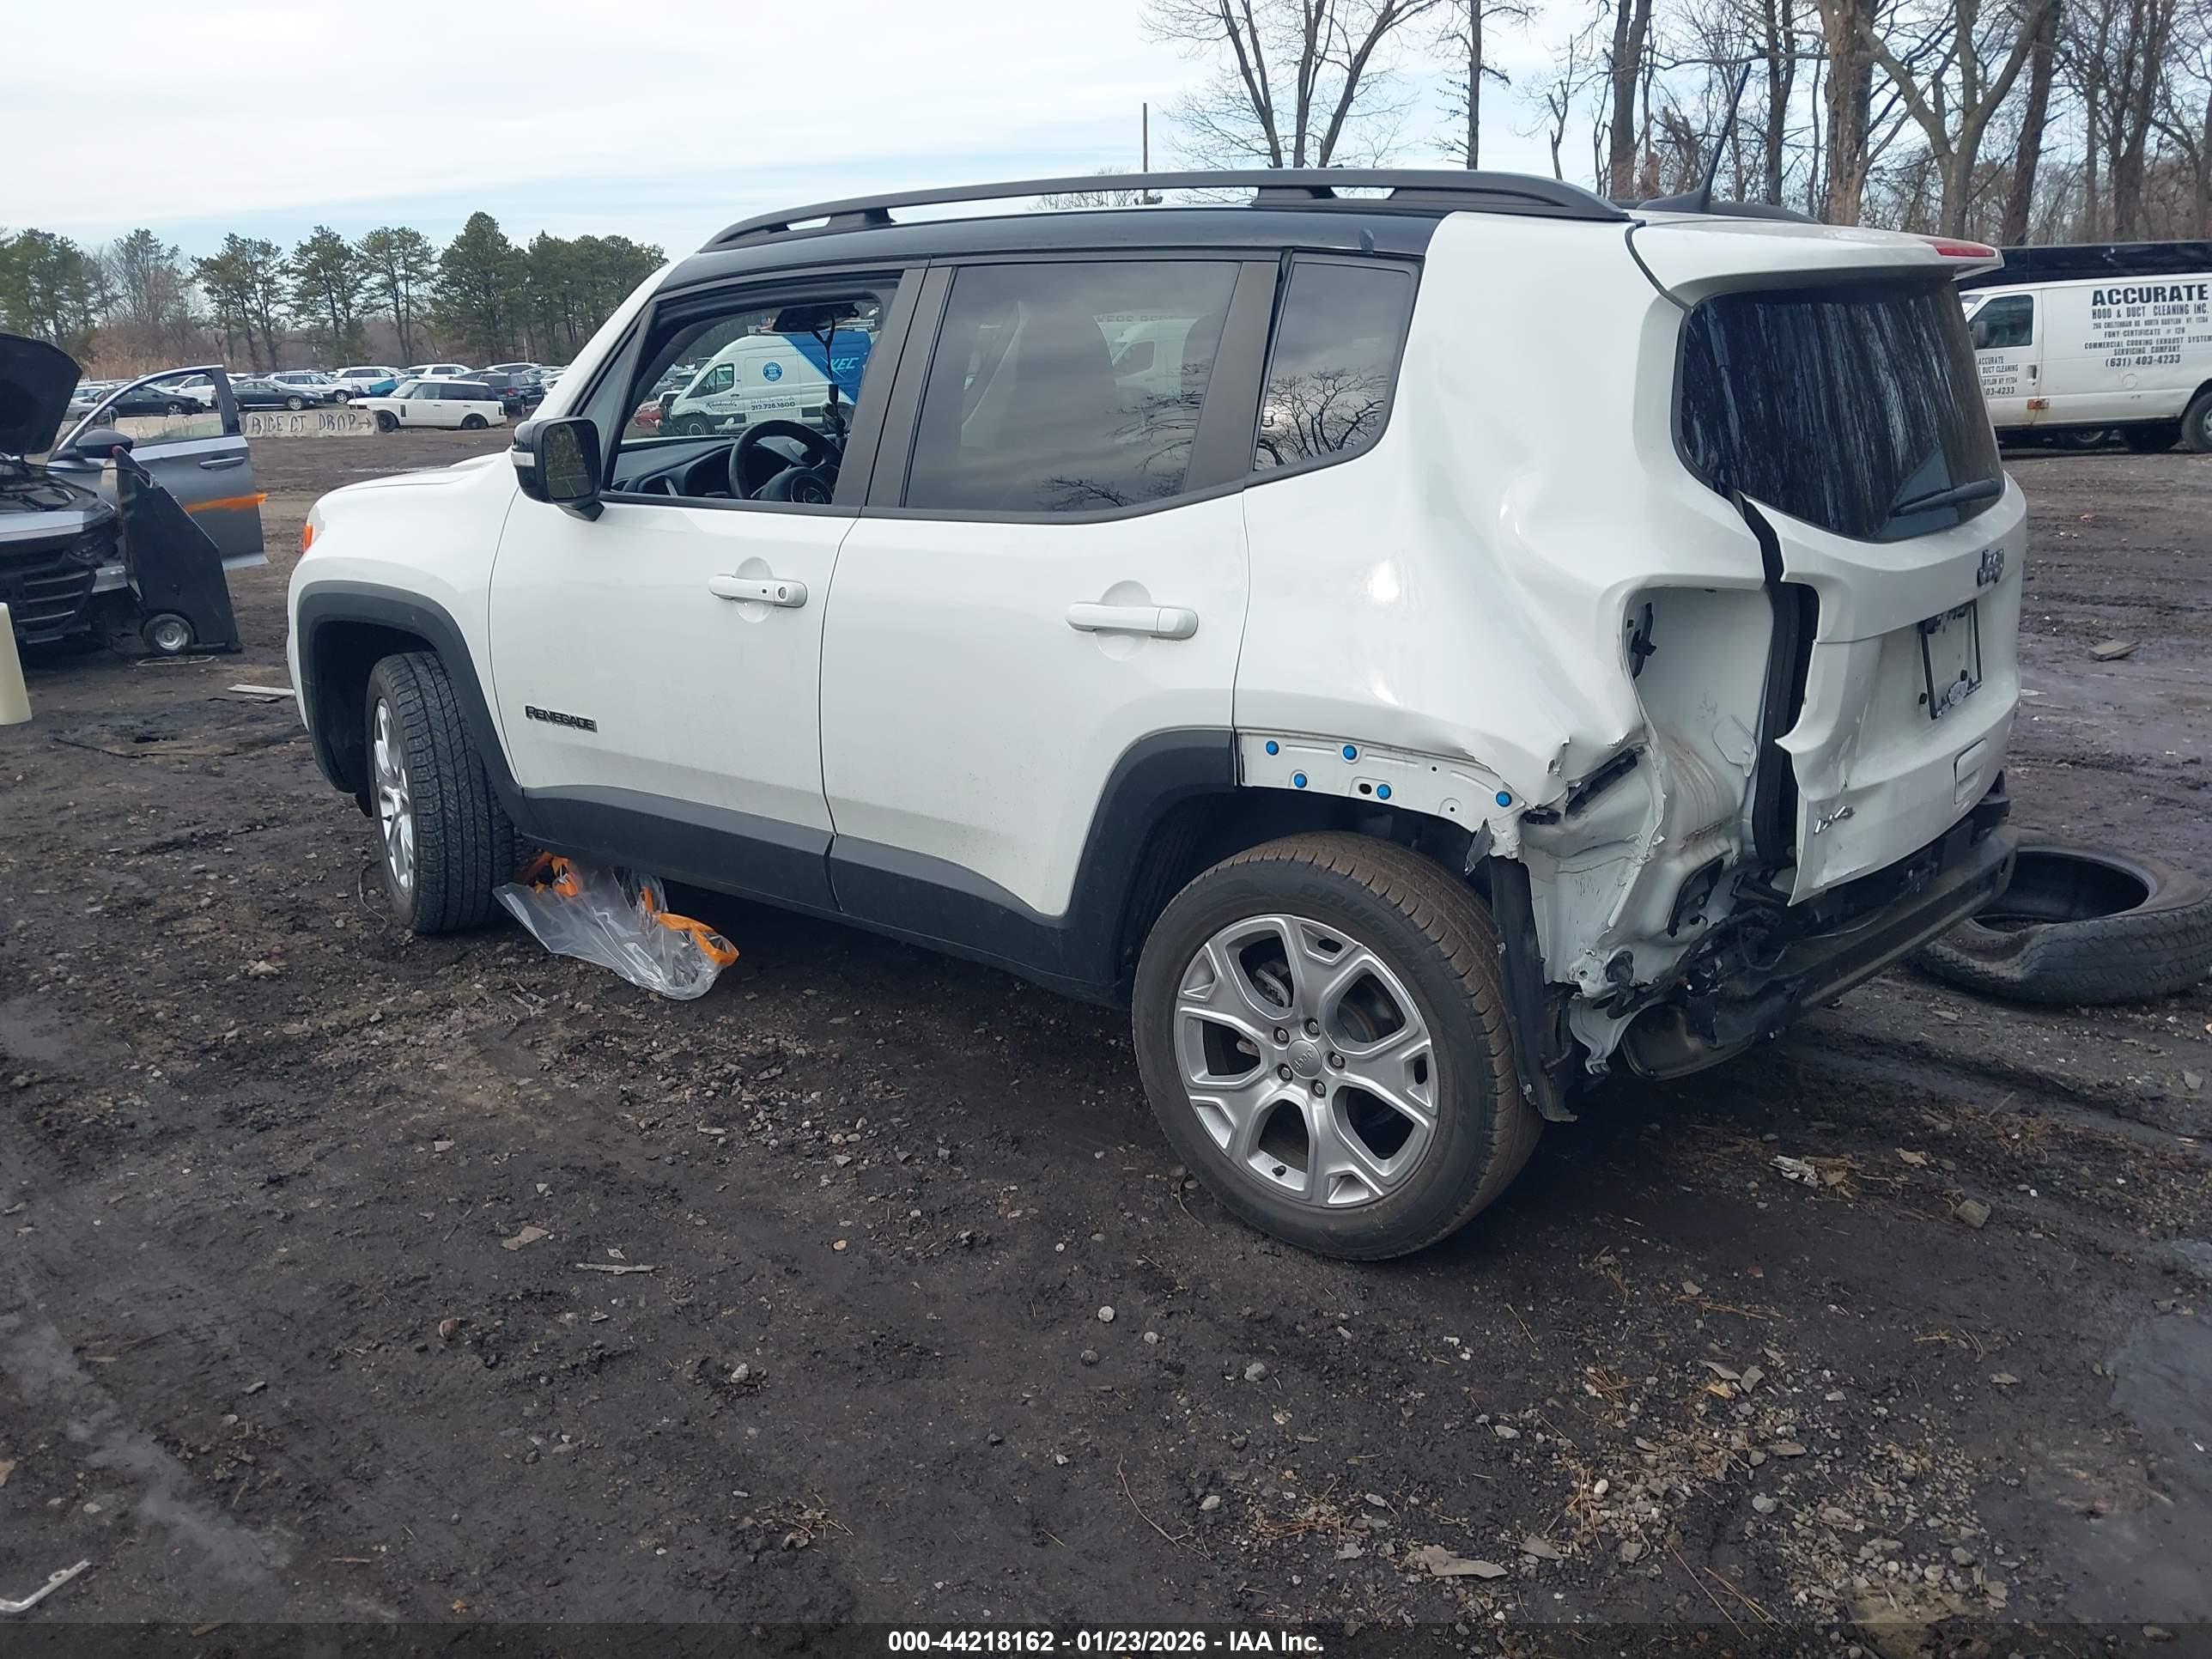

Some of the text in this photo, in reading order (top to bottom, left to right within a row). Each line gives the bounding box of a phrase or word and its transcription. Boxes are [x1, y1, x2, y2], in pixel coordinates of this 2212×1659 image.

[2092, 284, 2209, 307] ACCURATE
[2092, 303, 2209, 319] HOOD & DUCT CLEANING INC.
[2085, 341, 2124, 349] COMMERCIAL
[1978, 356, 2004, 365] ACCURATE
[2106, 354, 2181, 368] (631) 403-4233
[319, 413, 357, 431] DROP
[525, 705, 598, 732] RENEGADE
